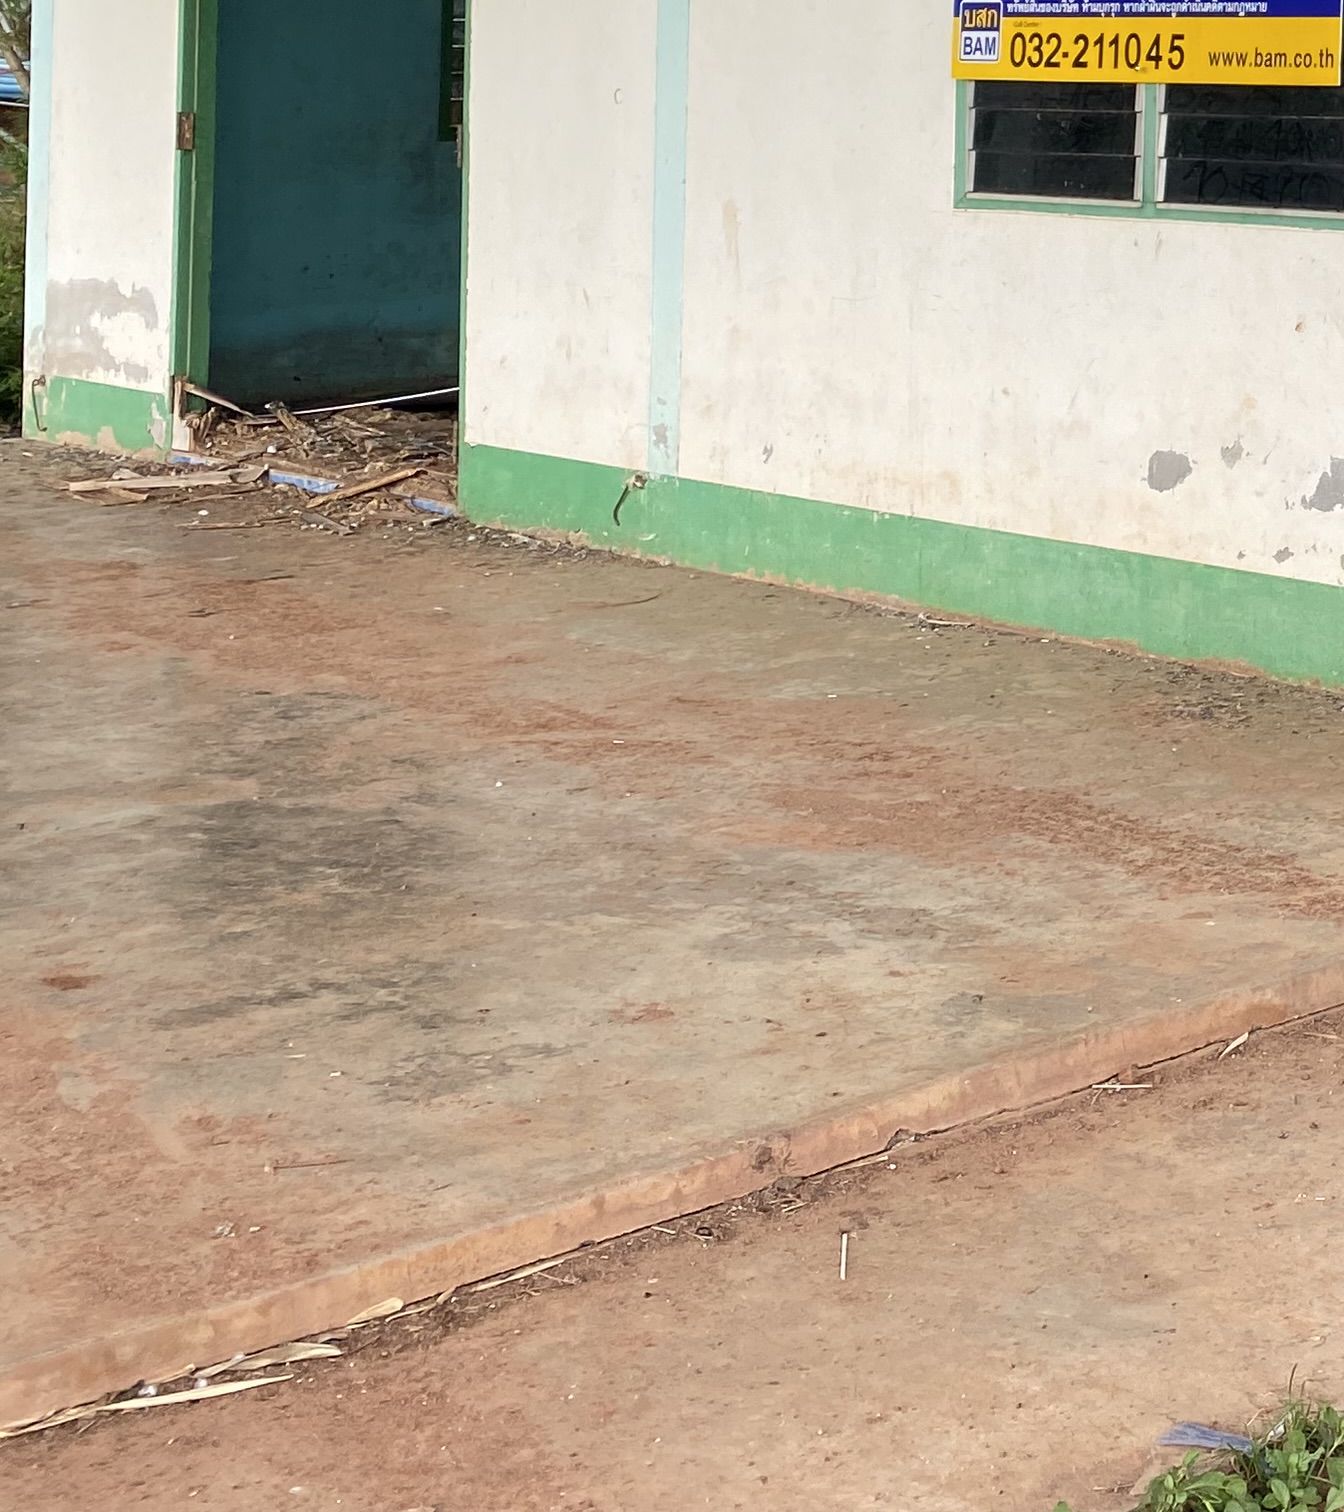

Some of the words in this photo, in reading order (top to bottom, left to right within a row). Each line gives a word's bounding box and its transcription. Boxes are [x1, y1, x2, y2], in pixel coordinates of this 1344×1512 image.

[964, 7, 998, 29] บสก
[963, 35, 997, 56] BAM
[1009, 31, 1185, 70] 032-211045
[1208, 47, 1335, 70] www.bam.co.th
